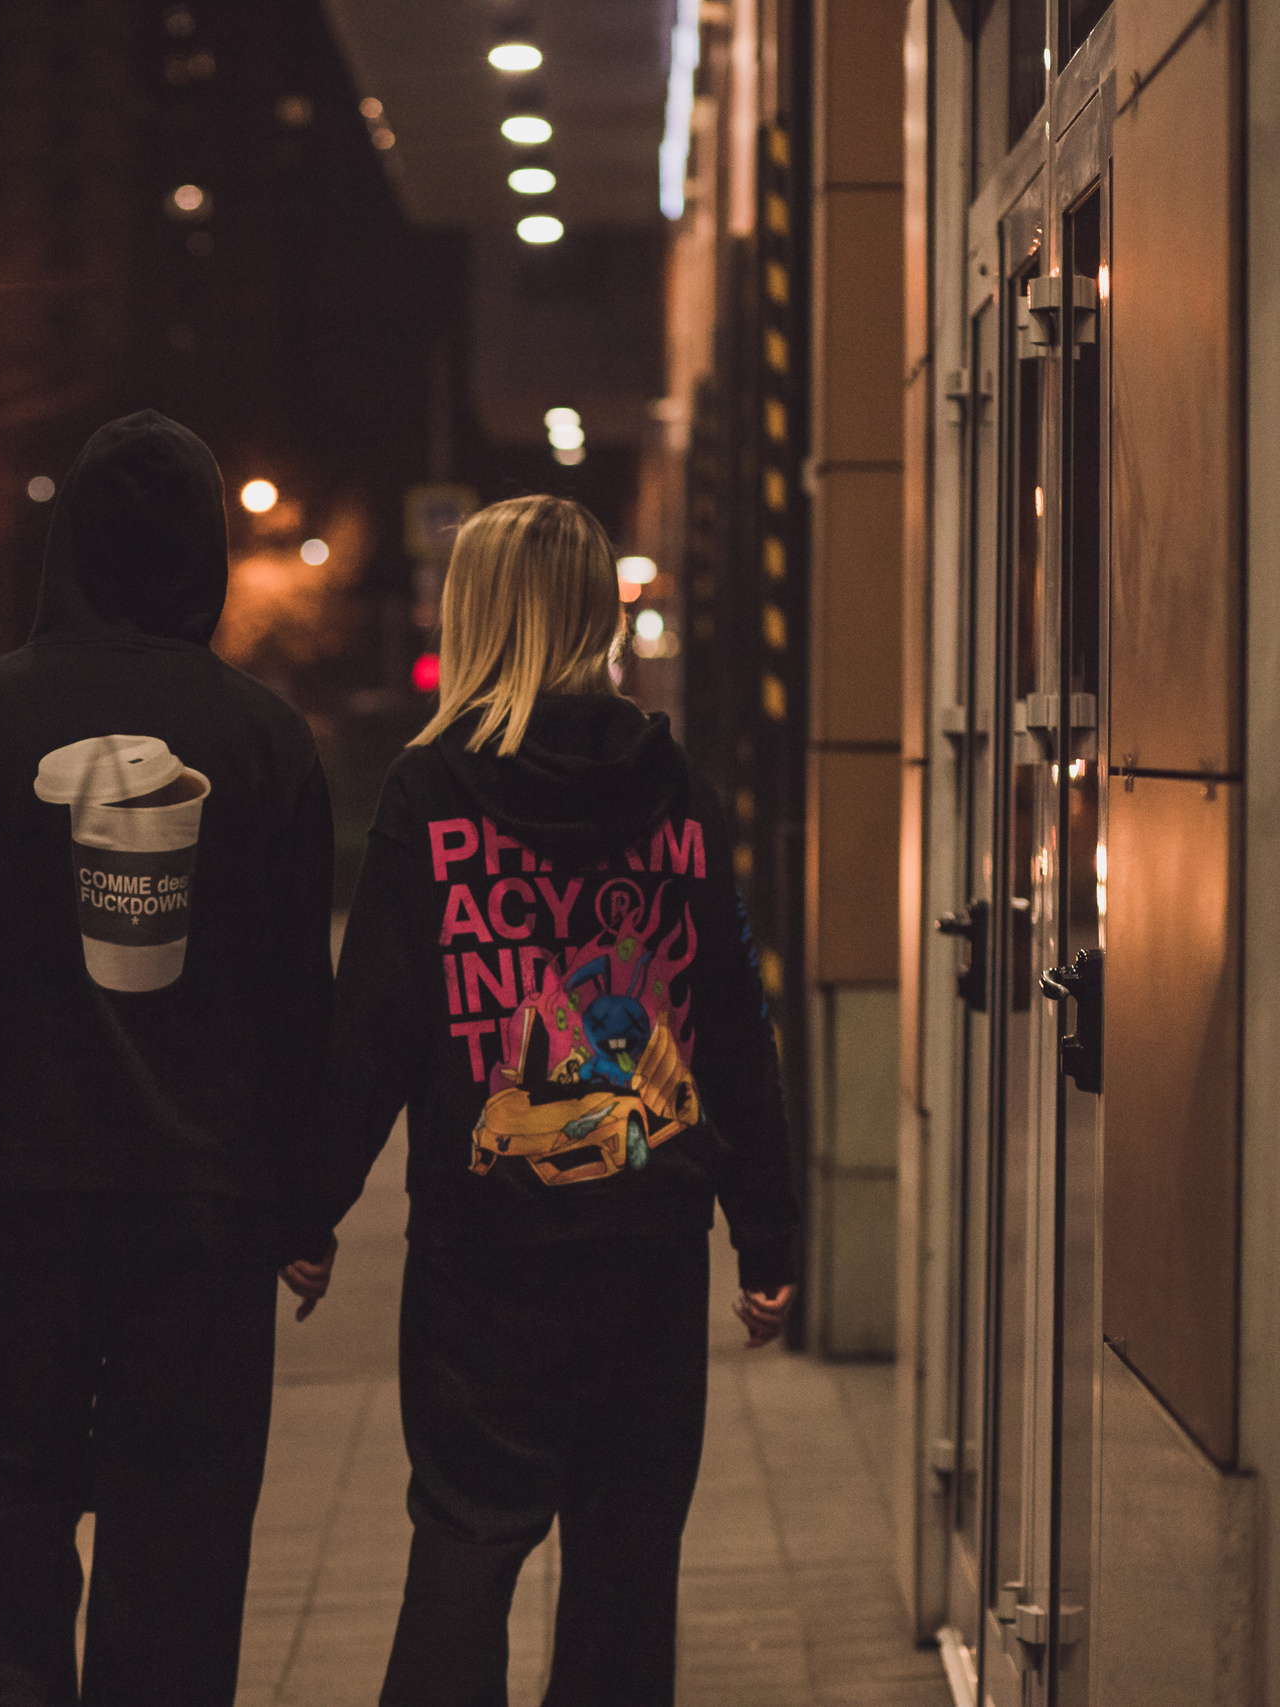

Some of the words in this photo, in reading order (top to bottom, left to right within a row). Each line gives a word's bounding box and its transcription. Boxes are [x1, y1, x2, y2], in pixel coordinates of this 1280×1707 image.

[80, 868, 151, 895] COMME
[157, 875, 189, 893] des
[81, 886, 188, 915] FUCKDOWN
[439, 877, 585, 947] ACY
